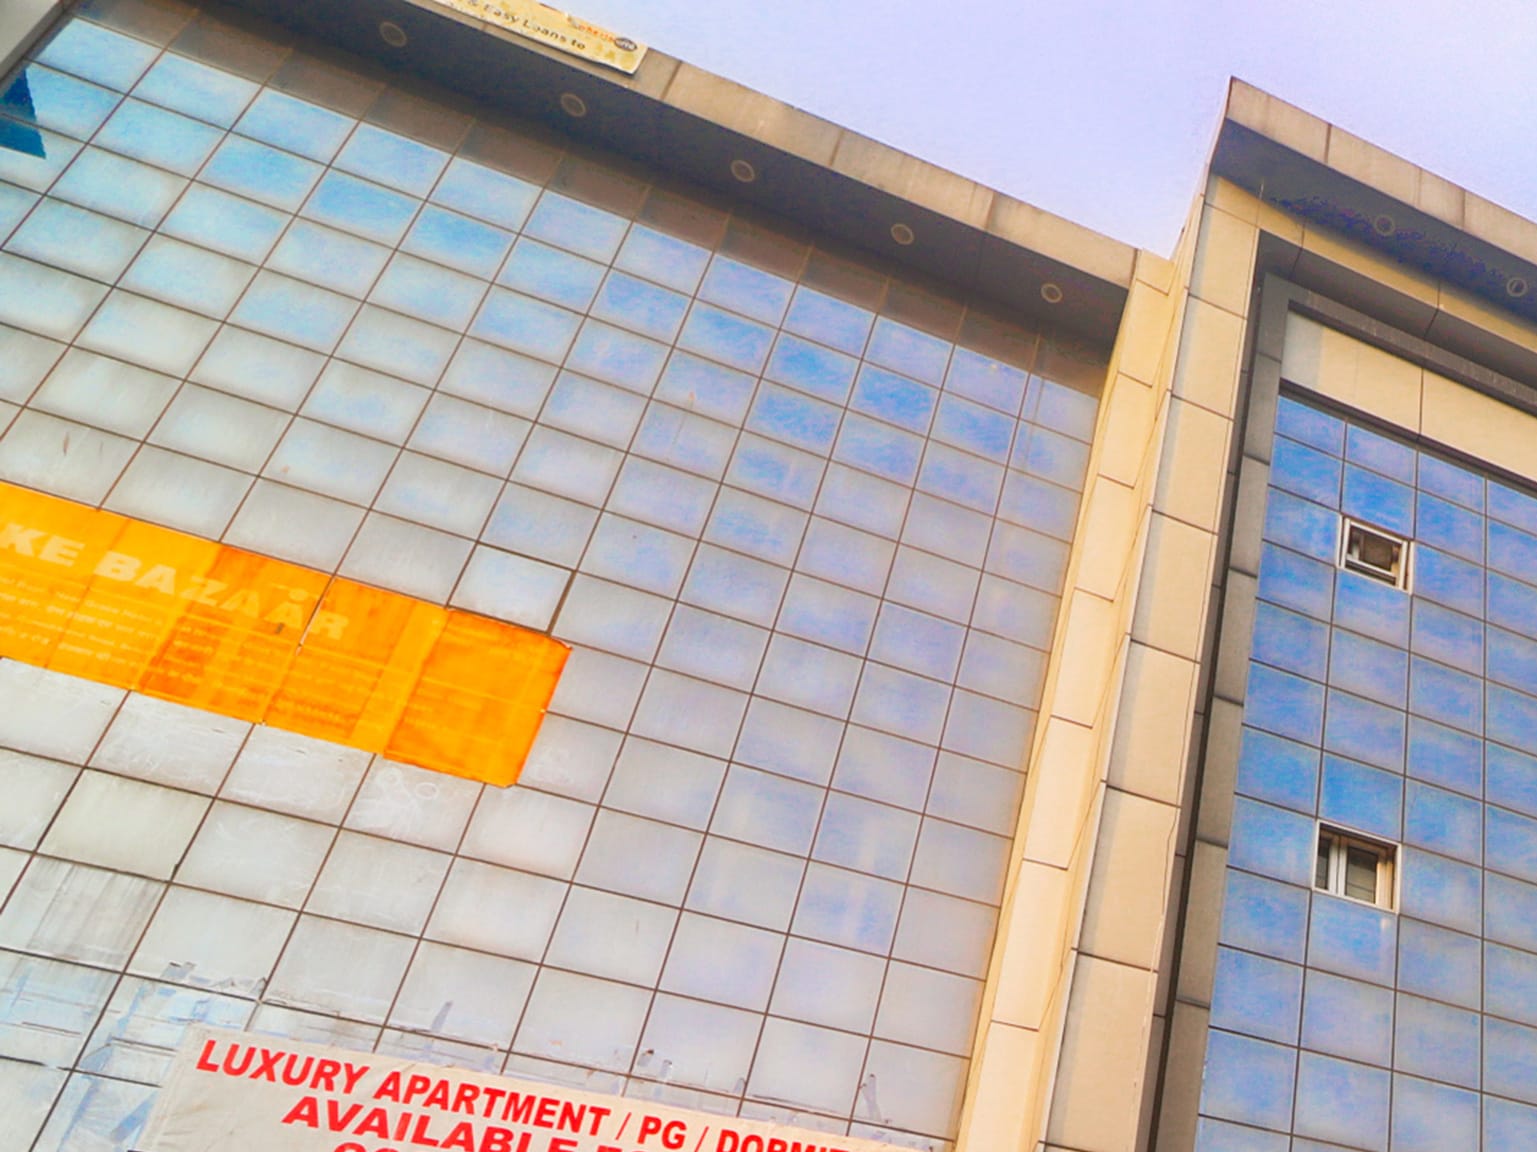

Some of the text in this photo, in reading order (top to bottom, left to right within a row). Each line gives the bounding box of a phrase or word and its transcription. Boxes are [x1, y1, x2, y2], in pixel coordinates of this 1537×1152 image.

[522, 19, 567, 43] Loans
[571, 36, 586, 50] to
[196, 1039, 369, 1094] LUXURY
[374, 1071, 610, 1137] APARTMENT
[637, 1115, 688, 1151] PG
